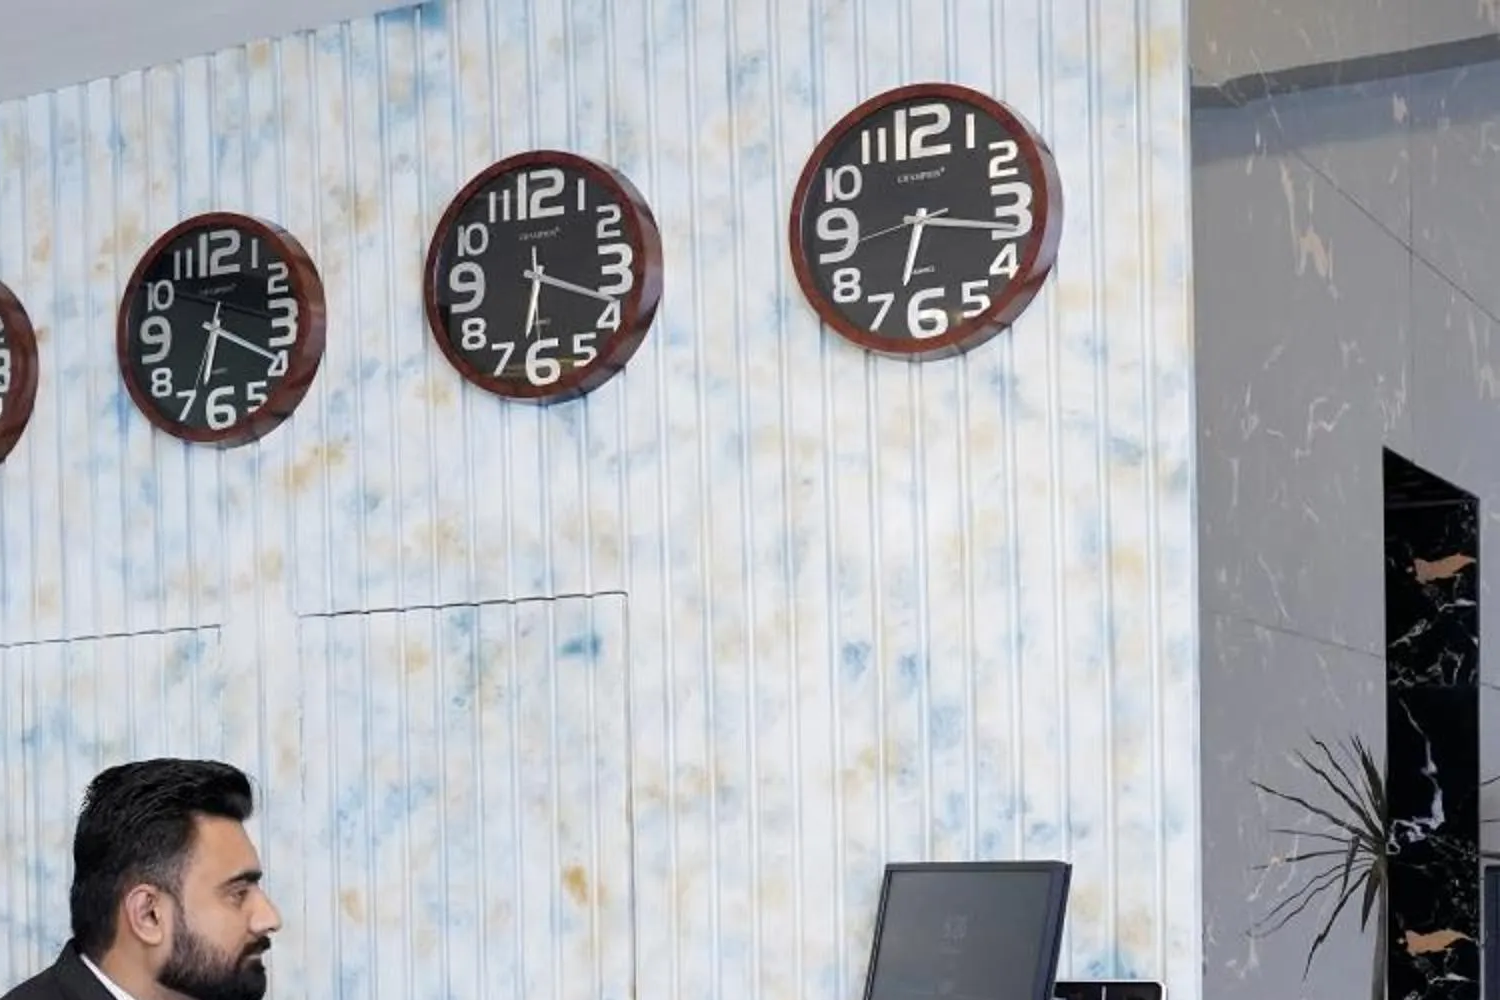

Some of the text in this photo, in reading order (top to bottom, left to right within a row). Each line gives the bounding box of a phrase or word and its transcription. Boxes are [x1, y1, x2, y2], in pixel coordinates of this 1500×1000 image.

[861, 127, 887, 165] 11
[894, 103, 950, 161] 12
[965, 113, 975, 149] 1
[988, 140, 1019, 178] 2
[517, 168, 565, 220] 12
[577, 178, 585, 211] 1
[825, 165, 862, 203] 10
[489, 189, 510, 223] 11
[596, 204, 621, 238] 2
[991, 181, 1033, 240] 3
[199, 229, 241, 277] 12
[251, 238, 259, 269] 1
[457, 222, 489, 257] 10
[816, 207, 860, 264] 9
[174, 248, 193, 280] 11
[267, 262, 289, 295] 2
[597, 243, 633, 296] 3
[989, 243, 1020, 280] 4
[147, 279, 175, 311] 10
[450, 262, 486, 314] 9
[832, 268, 861, 303] 8
[961, 279, 991, 318] 5
[268, 298, 298, 347] 3
[596, 300, 621, 332] 4
[867, 293, 895, 331] 7
[907, 287, 948, 338] 6
[140, 316, 172, 364] 9
[461, 318, 487, 350] 8
[572, 333, 597, 367] 5
[267, 350, 288, 377] 4
[491, 342, 515, 377] 7
[525, 338, 561, 386] 6
[151, 367, 173, 398] 8
[247, 381, 268, 412] 5
[176, 389, 197, 421] 7
[205, 386, 237, 430] 6
